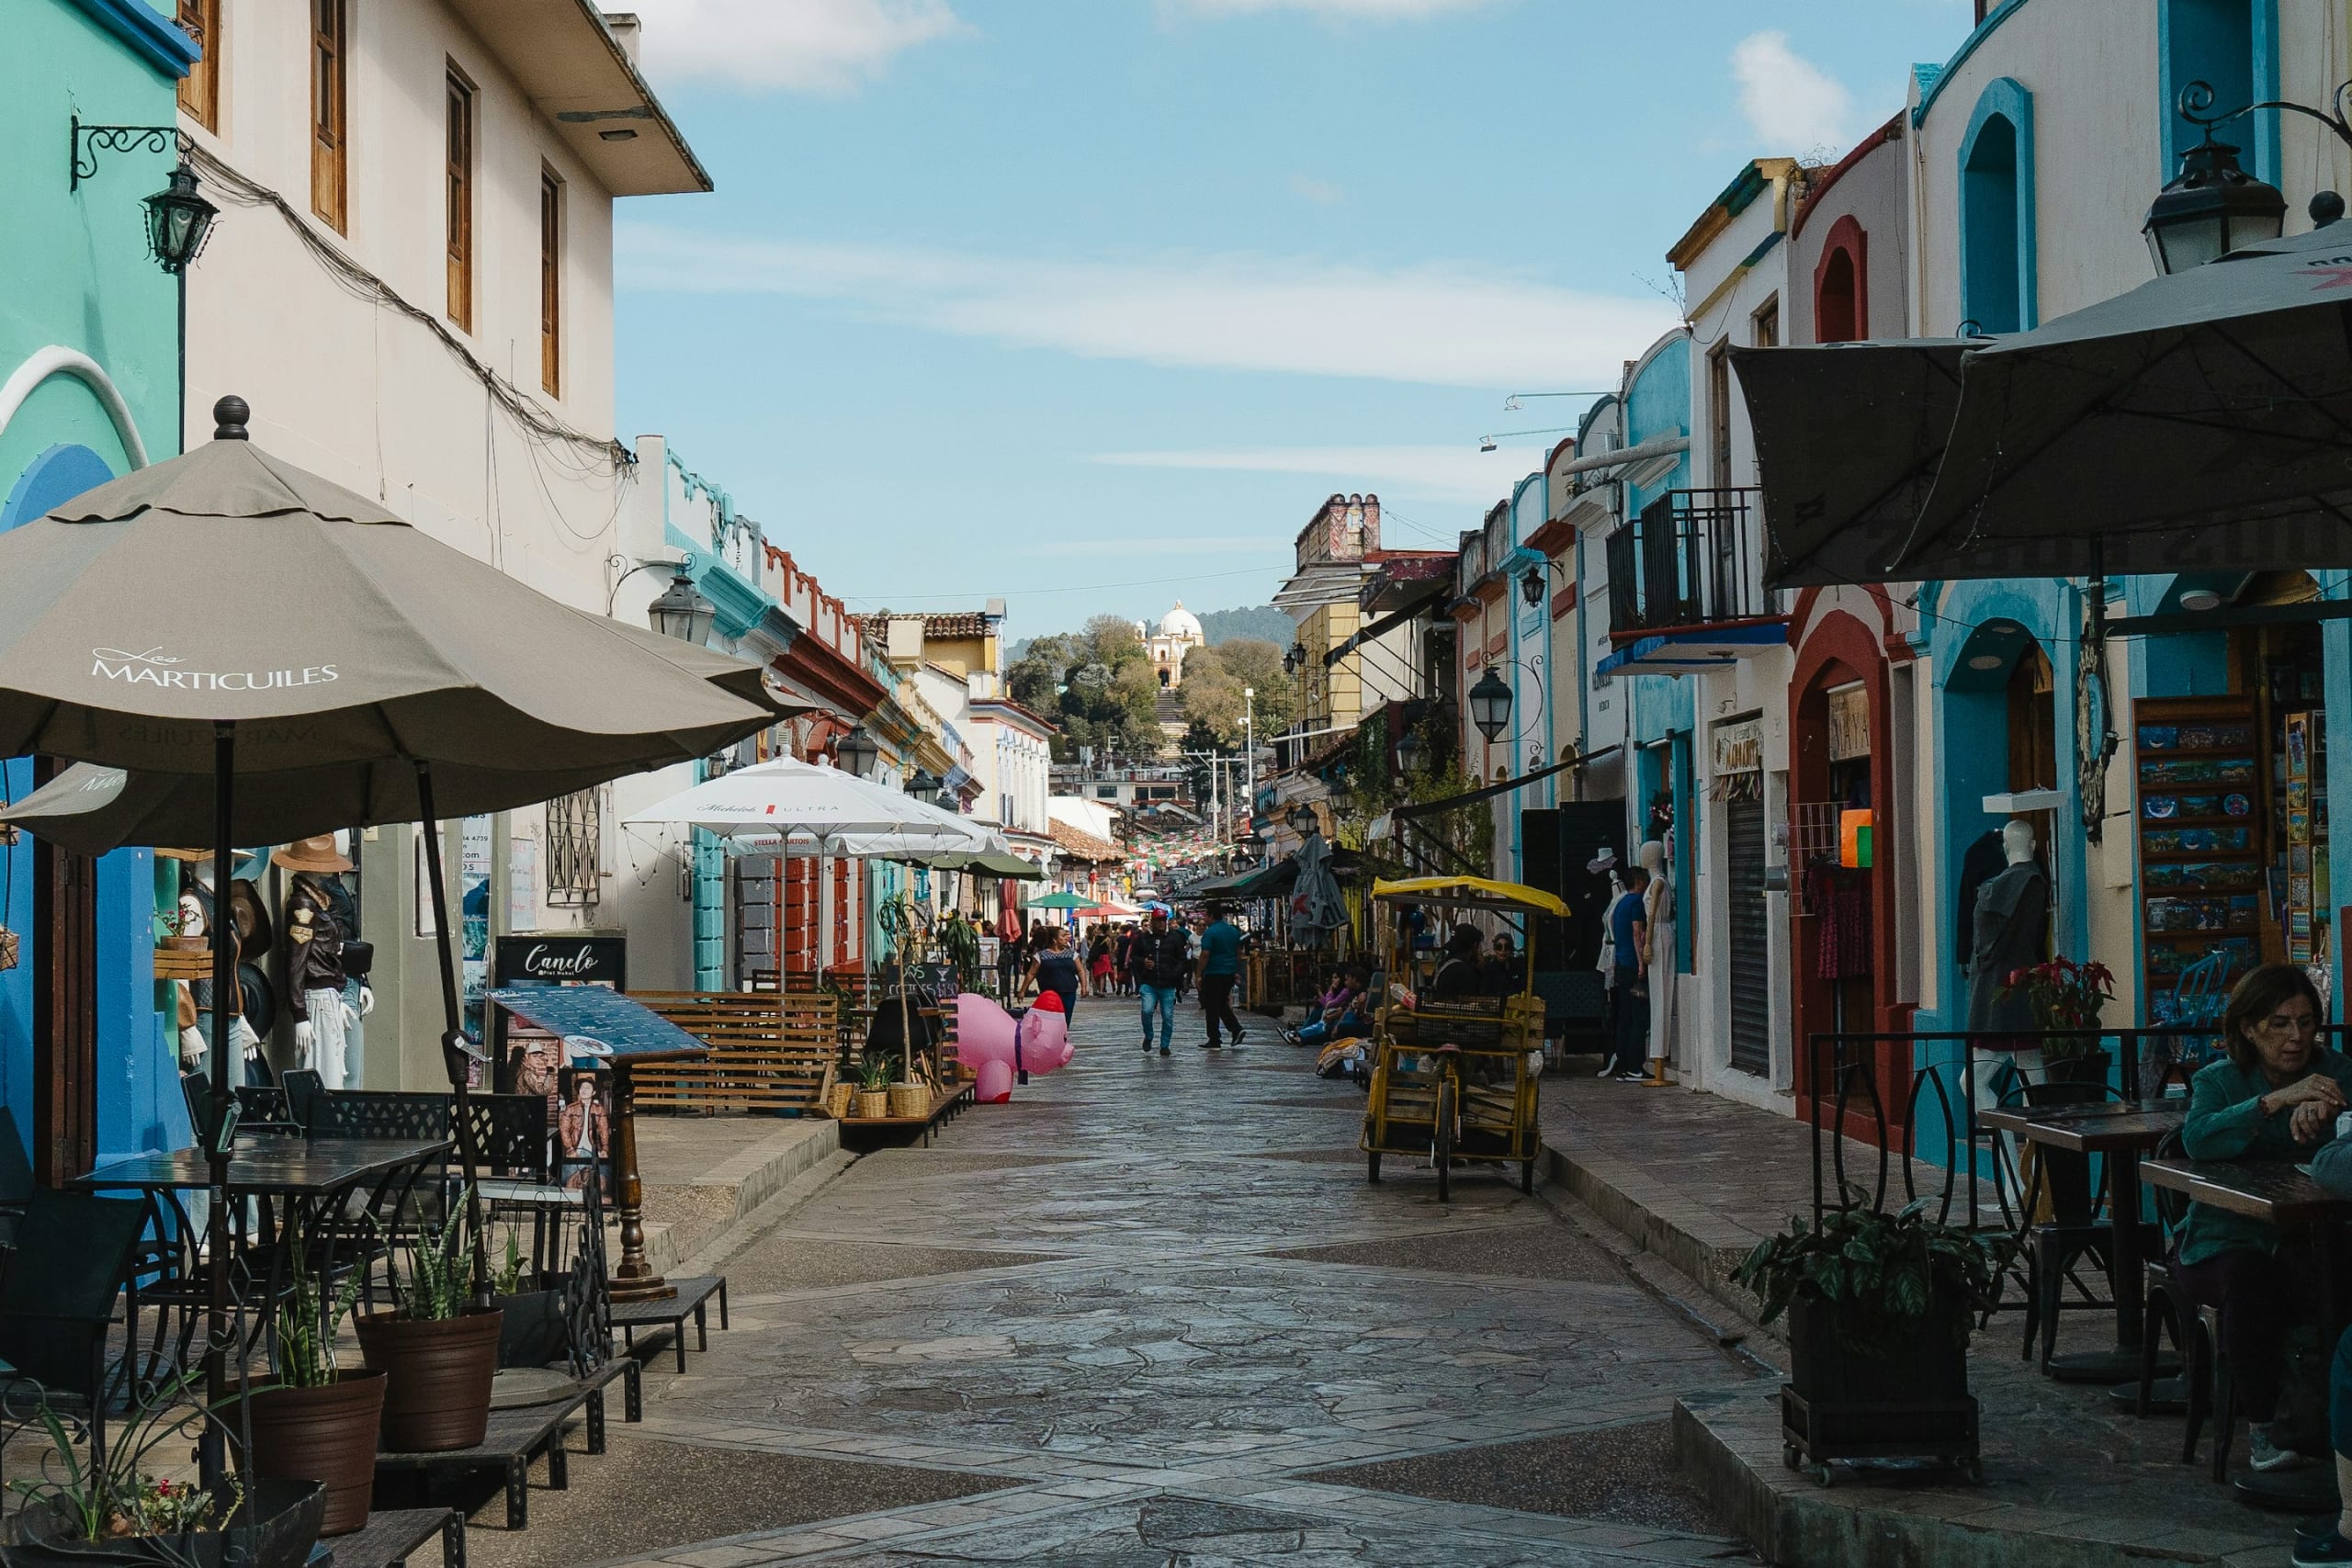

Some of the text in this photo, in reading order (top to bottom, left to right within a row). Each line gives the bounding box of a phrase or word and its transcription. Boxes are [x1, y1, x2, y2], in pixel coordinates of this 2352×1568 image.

[92, 646, 189, 666] Los
[91, 659, 339, 691] MARTICUILES
[784, 806, 840, 814] ULTRA
[753, 839, 778, 847] STELLA
[525, 943, 599, 974] Canelo
